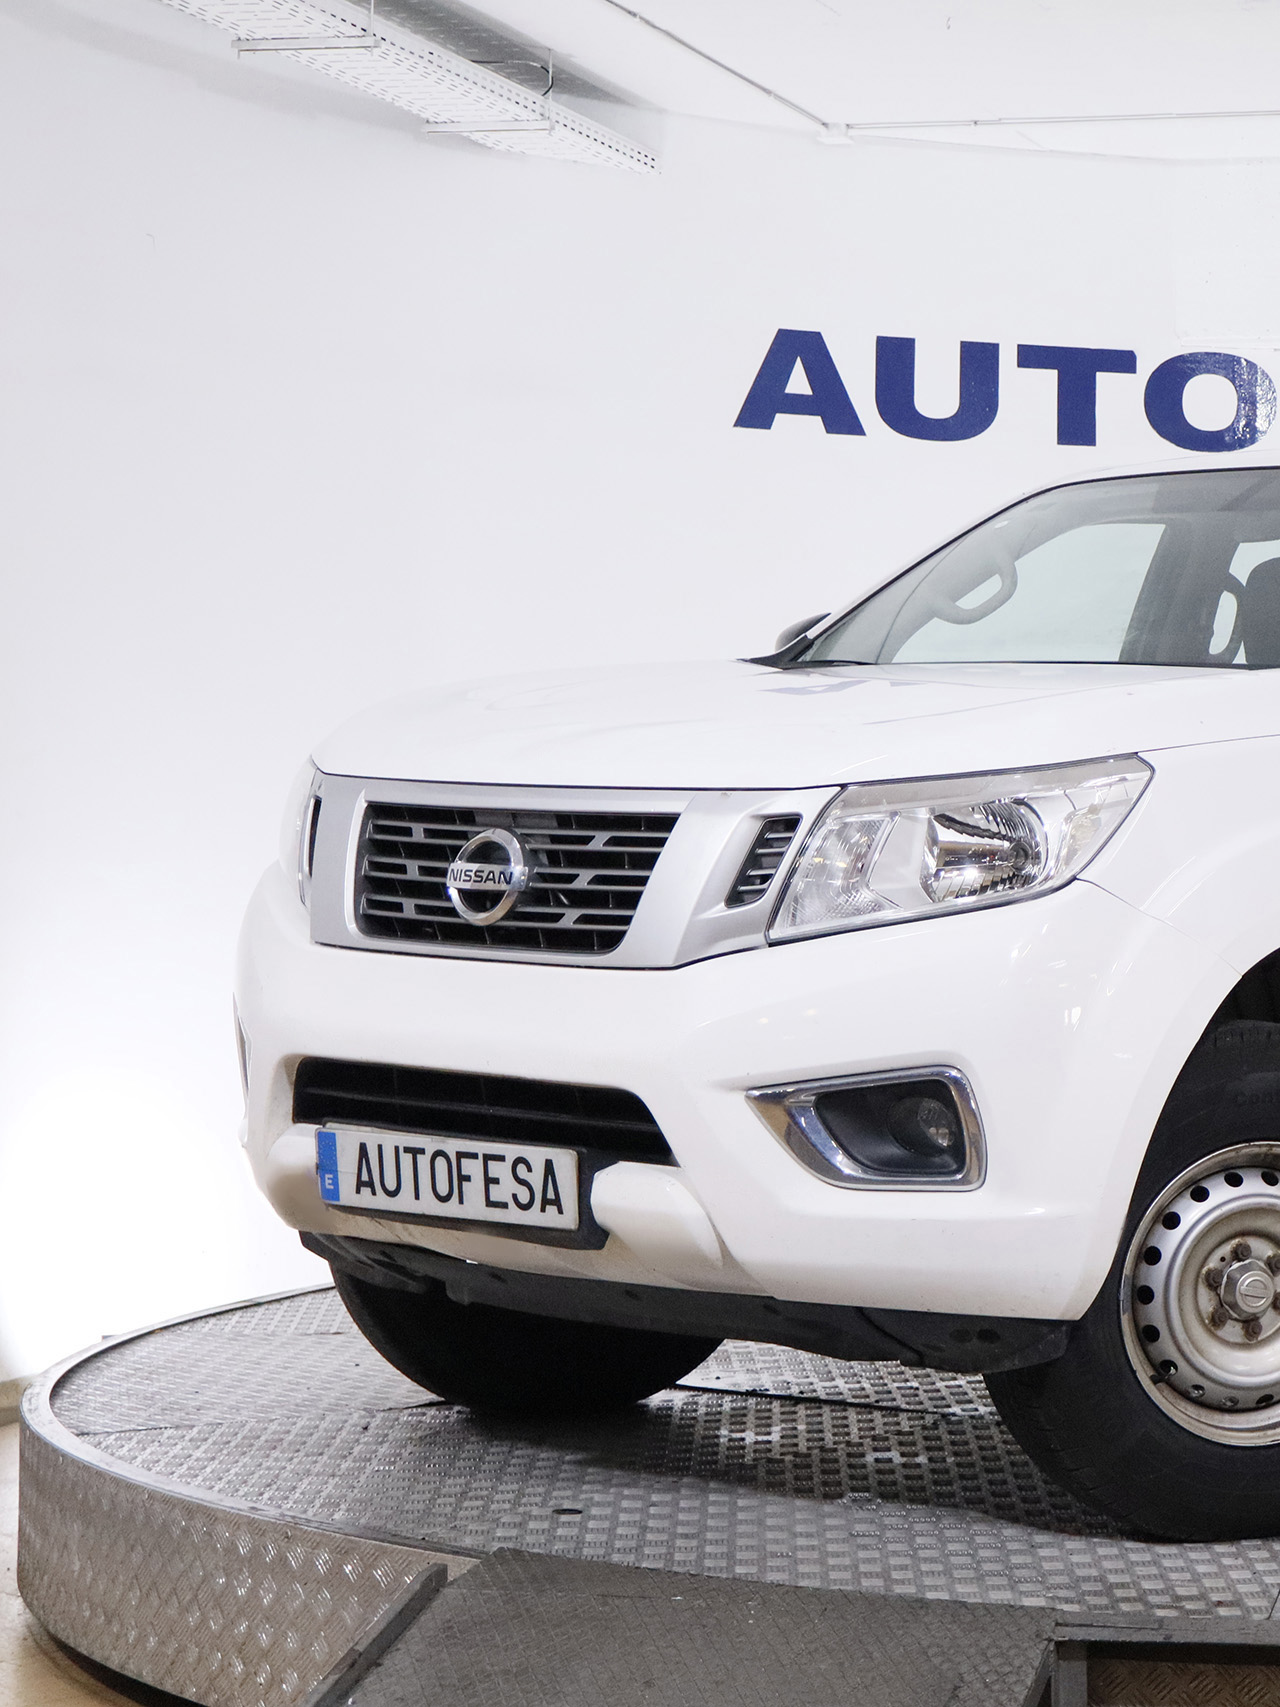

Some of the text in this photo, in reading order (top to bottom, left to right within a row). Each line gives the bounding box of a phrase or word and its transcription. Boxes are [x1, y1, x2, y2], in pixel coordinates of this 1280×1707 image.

[449, 868, 513, 885] NISSAN
[324, 1142, 564, 1215] E AUTOFESA
